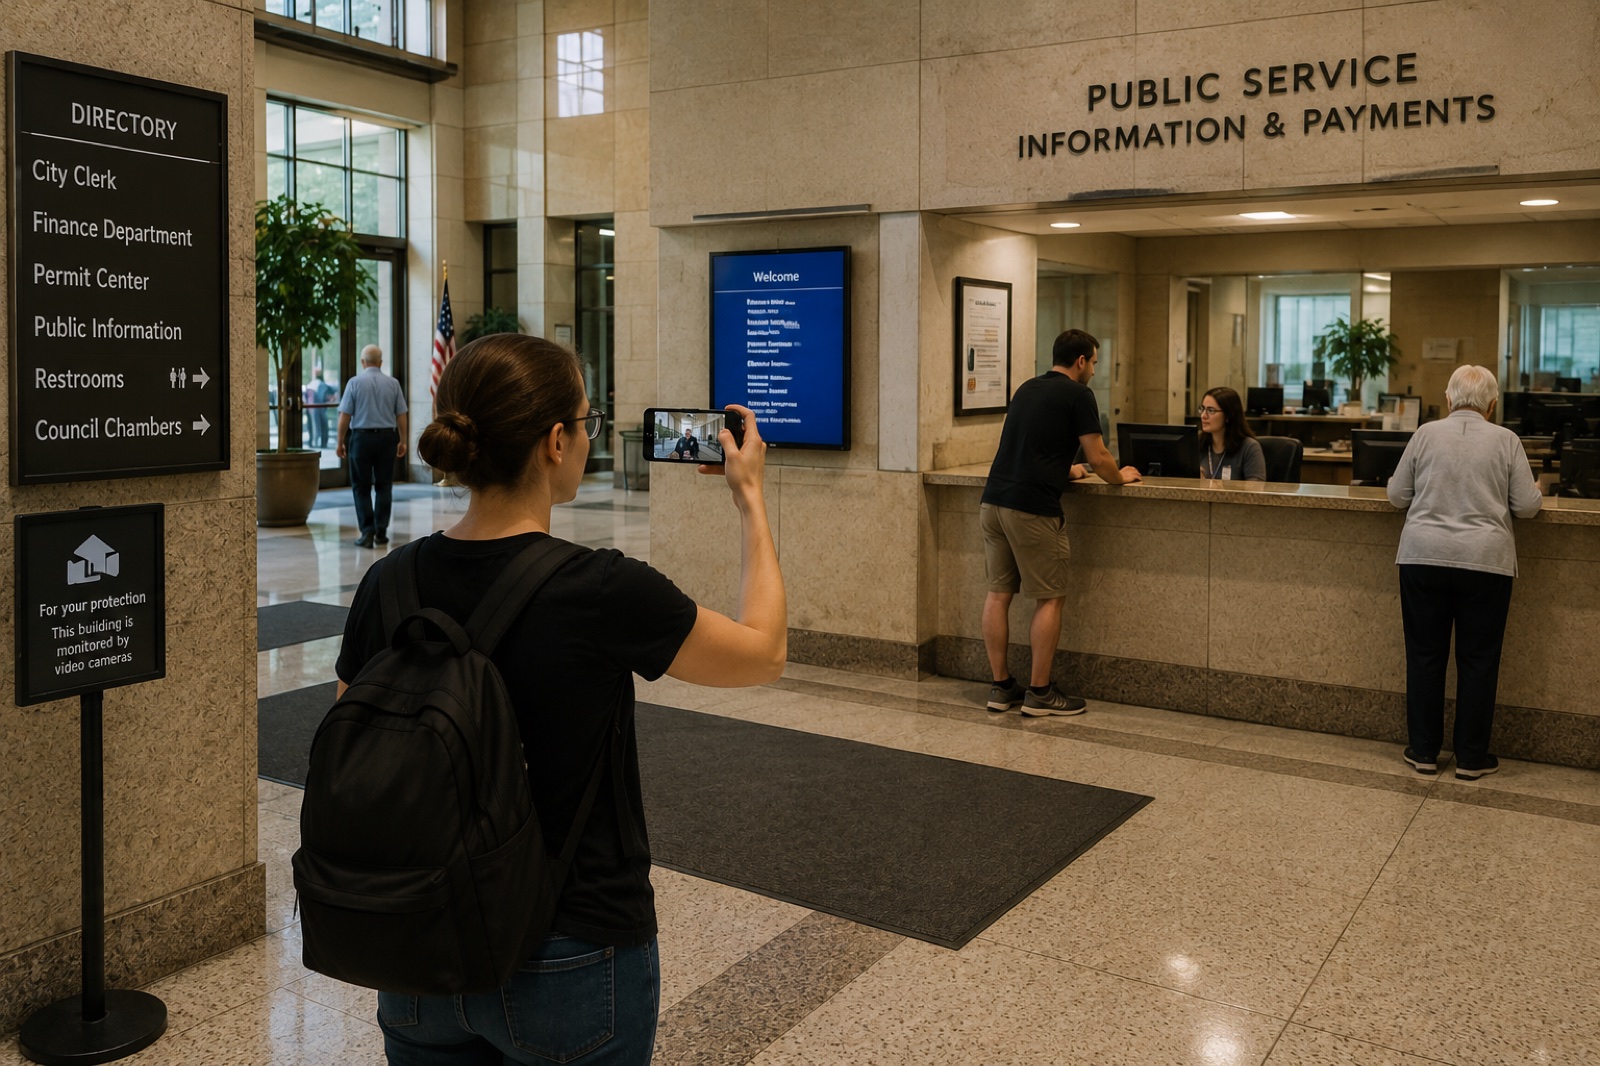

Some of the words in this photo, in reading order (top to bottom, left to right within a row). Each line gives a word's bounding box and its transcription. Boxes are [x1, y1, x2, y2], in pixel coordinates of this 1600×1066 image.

[1089, 73, 1219, 111] PUBLIC
[1243, 53, 1418, 97] SERVICE
[71, 103, 177, 141] DIRECTORY
[1019, 115, 1245, 158] INFORMATION
[1263, 112, 1285, 138] &
[1304, 94, 1496, 135] PAYMENTS
[33, 159, 67, 188] City
[74, 165, 116, 189] Clerk
[34, 211, 98, 237] Finance
[104, 219, 192, 246] Department
[35, 263, 91, 287] Permit
[96, 267, 149, 291] Center
[753, 271, 799, 282] Welcome
[35, 316, 86, 337] Public
[93, 318, 181, 340] Information
[36, 368, 124, 388] Restrooms
[36, 418, 98, 440] Council
[105, 416, 181, 437] Chambers
[40, 604, 57, 617] For
[62, 602, 87, 617] your
[91, 593, 145, 612] protection
[52, 625, 75, 640] This
[78, 619, 122, 635] building
[125, 616, 134, 628] is
[56, 636, 114, 658] monitored
[118, 636, 129, 648] by
[54, 660, 85, 676] video
[89, 653, 132, 668] cameras
